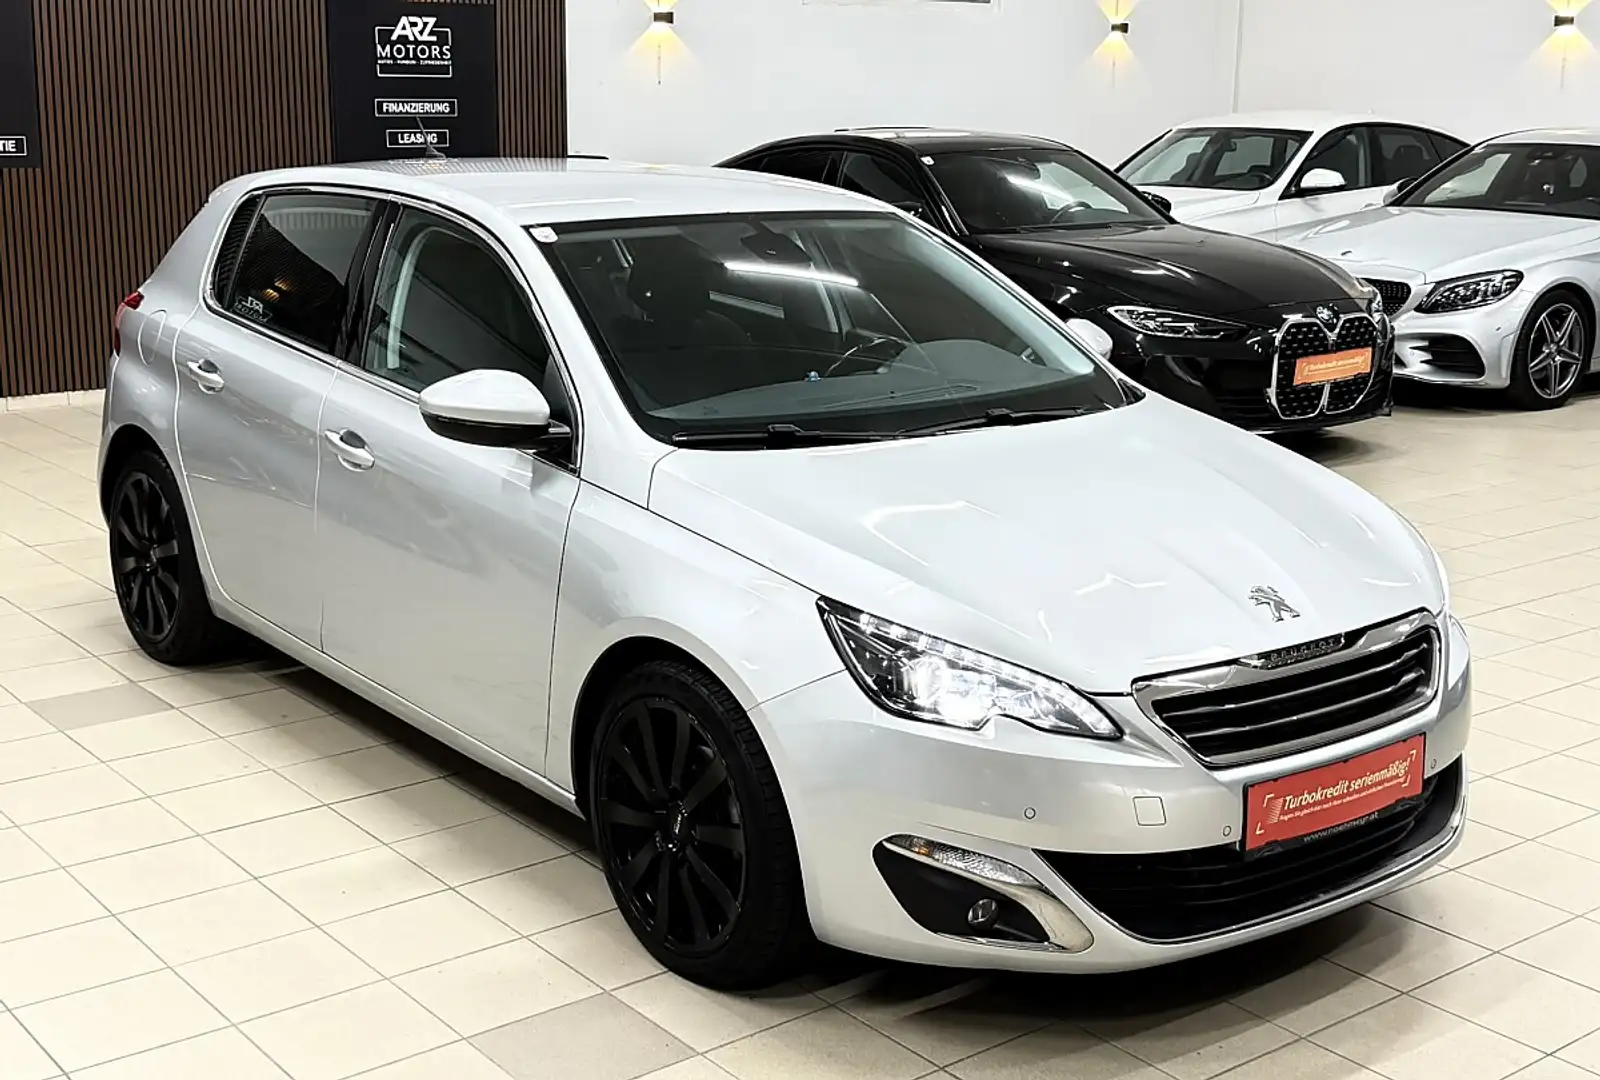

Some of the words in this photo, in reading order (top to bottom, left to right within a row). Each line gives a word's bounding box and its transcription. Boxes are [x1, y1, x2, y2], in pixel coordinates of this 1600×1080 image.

[390, 15, 438, 42] ARZ
[377, 44, 451, 59] MOTORS
[382, 102, 451, 113] FINANZIERUNG
[1284, 780, 1349, 811] Turbokredit
